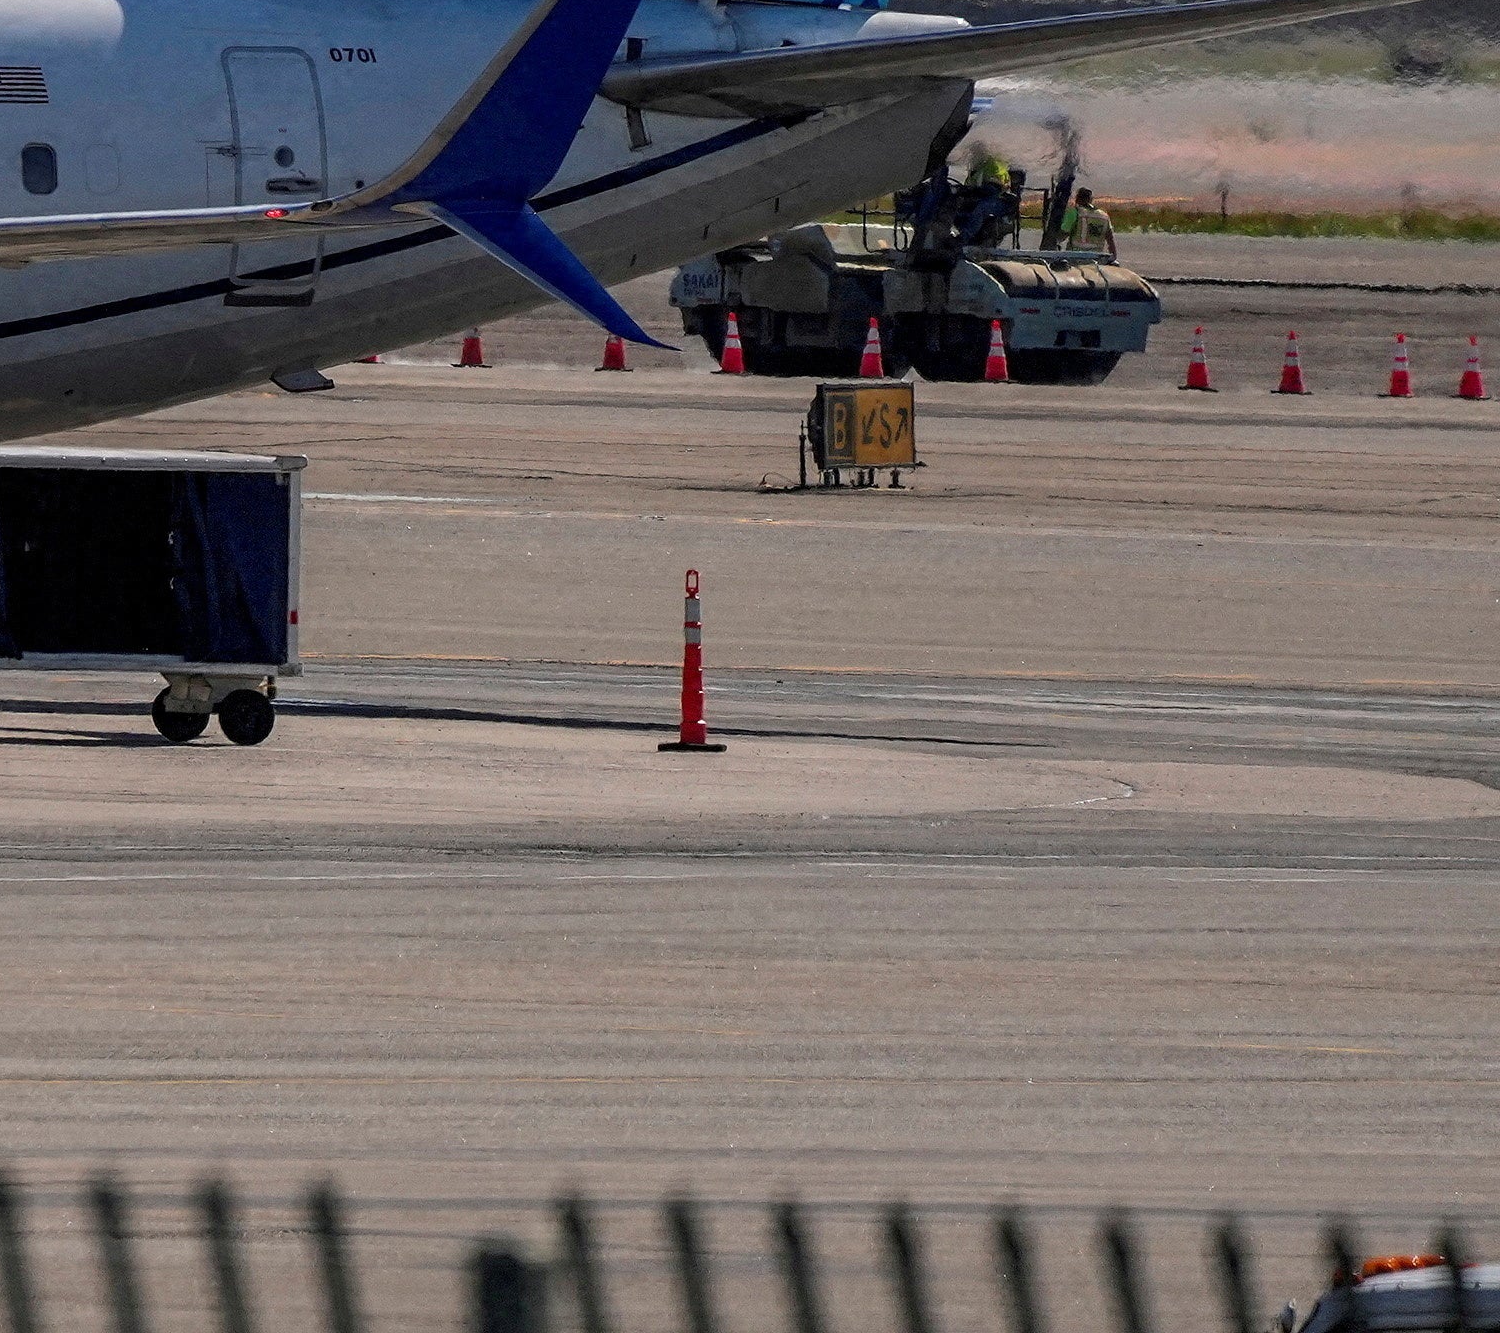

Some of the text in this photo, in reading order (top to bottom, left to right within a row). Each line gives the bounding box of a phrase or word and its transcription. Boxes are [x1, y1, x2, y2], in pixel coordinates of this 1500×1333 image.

[329, 47, 377, 64] 0701
[683, 274, 719, 288] SAKAI
[834, 402, 892, 450] B S
